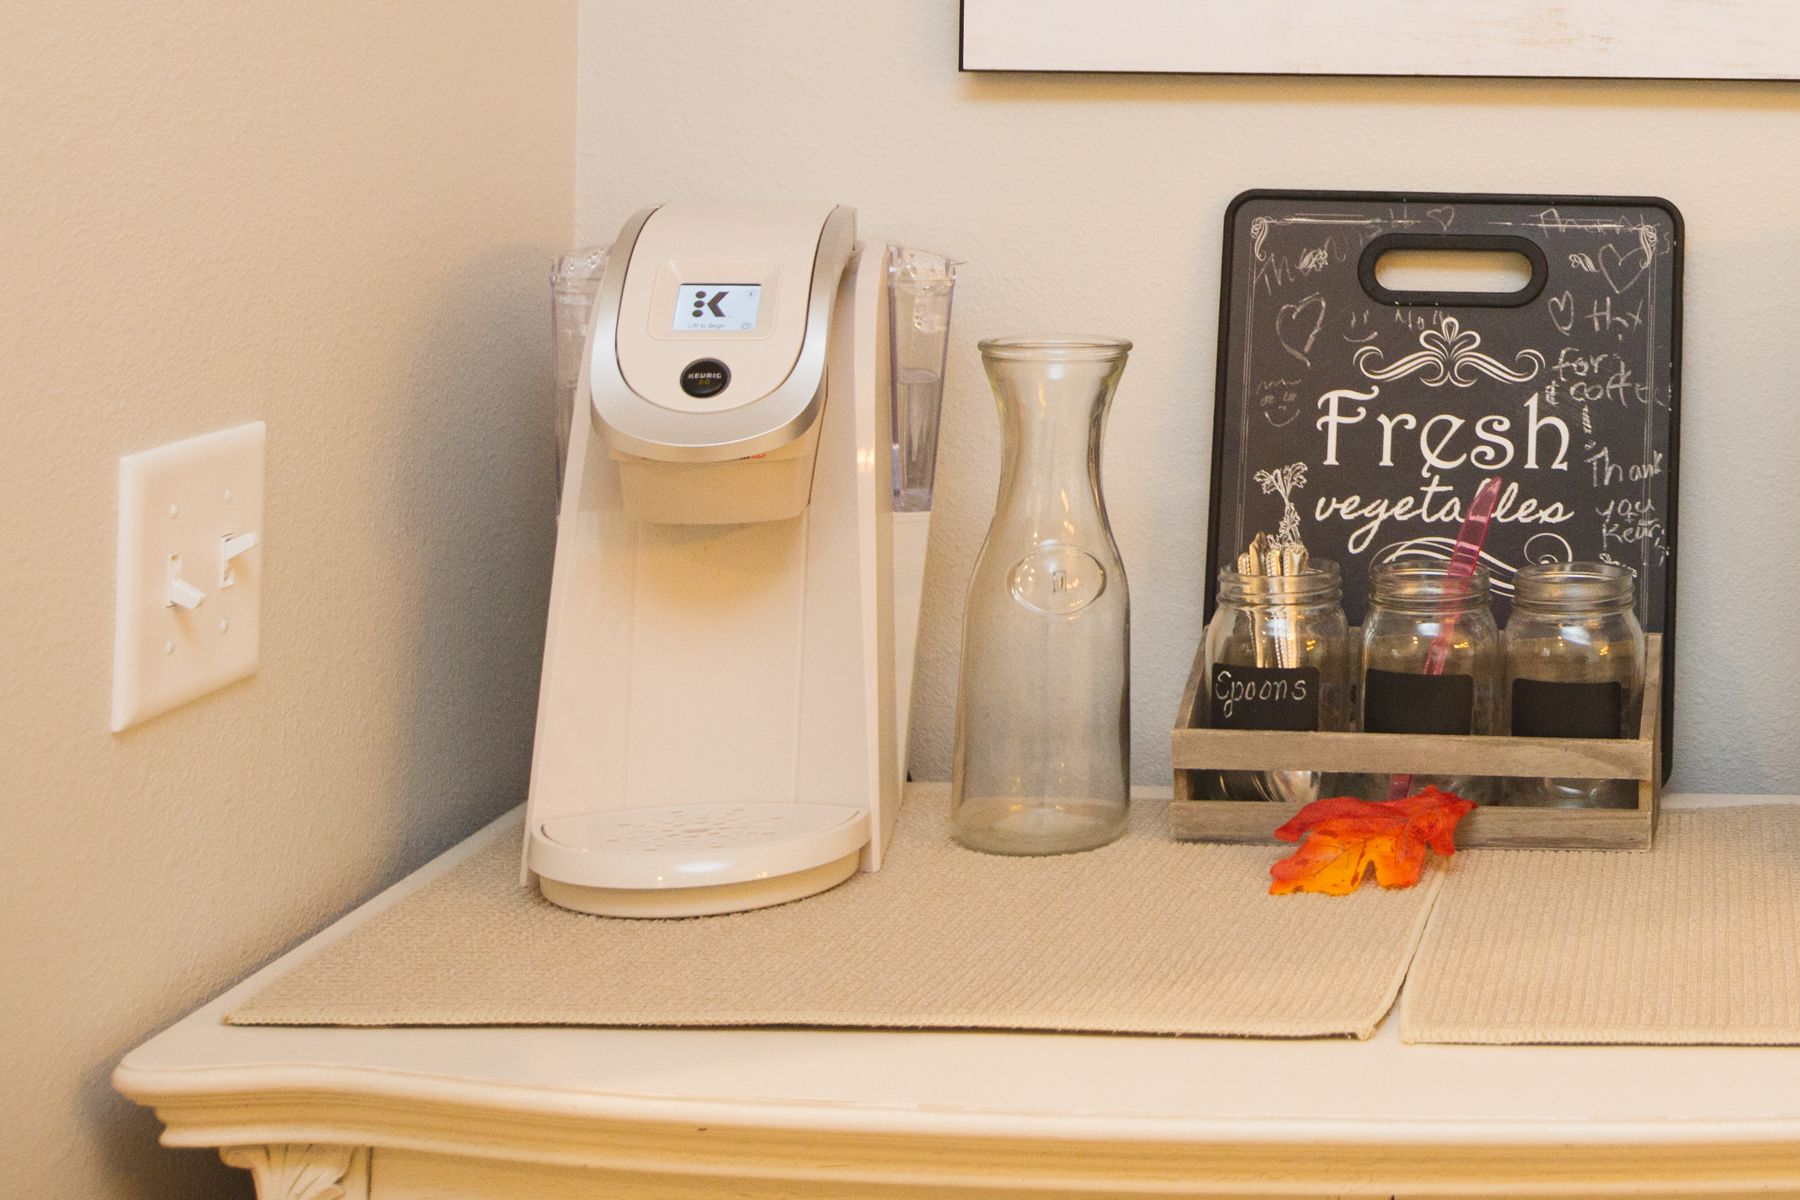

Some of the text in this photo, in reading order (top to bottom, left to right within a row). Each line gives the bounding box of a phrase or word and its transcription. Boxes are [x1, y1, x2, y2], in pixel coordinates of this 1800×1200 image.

[687, 371, 722, 380] KEURIG
[1315, 384, 1571, 479] Fresh
[1314, 474, 1575, 555] vegetales
[1215, 670, 1307, 718] Spoons
